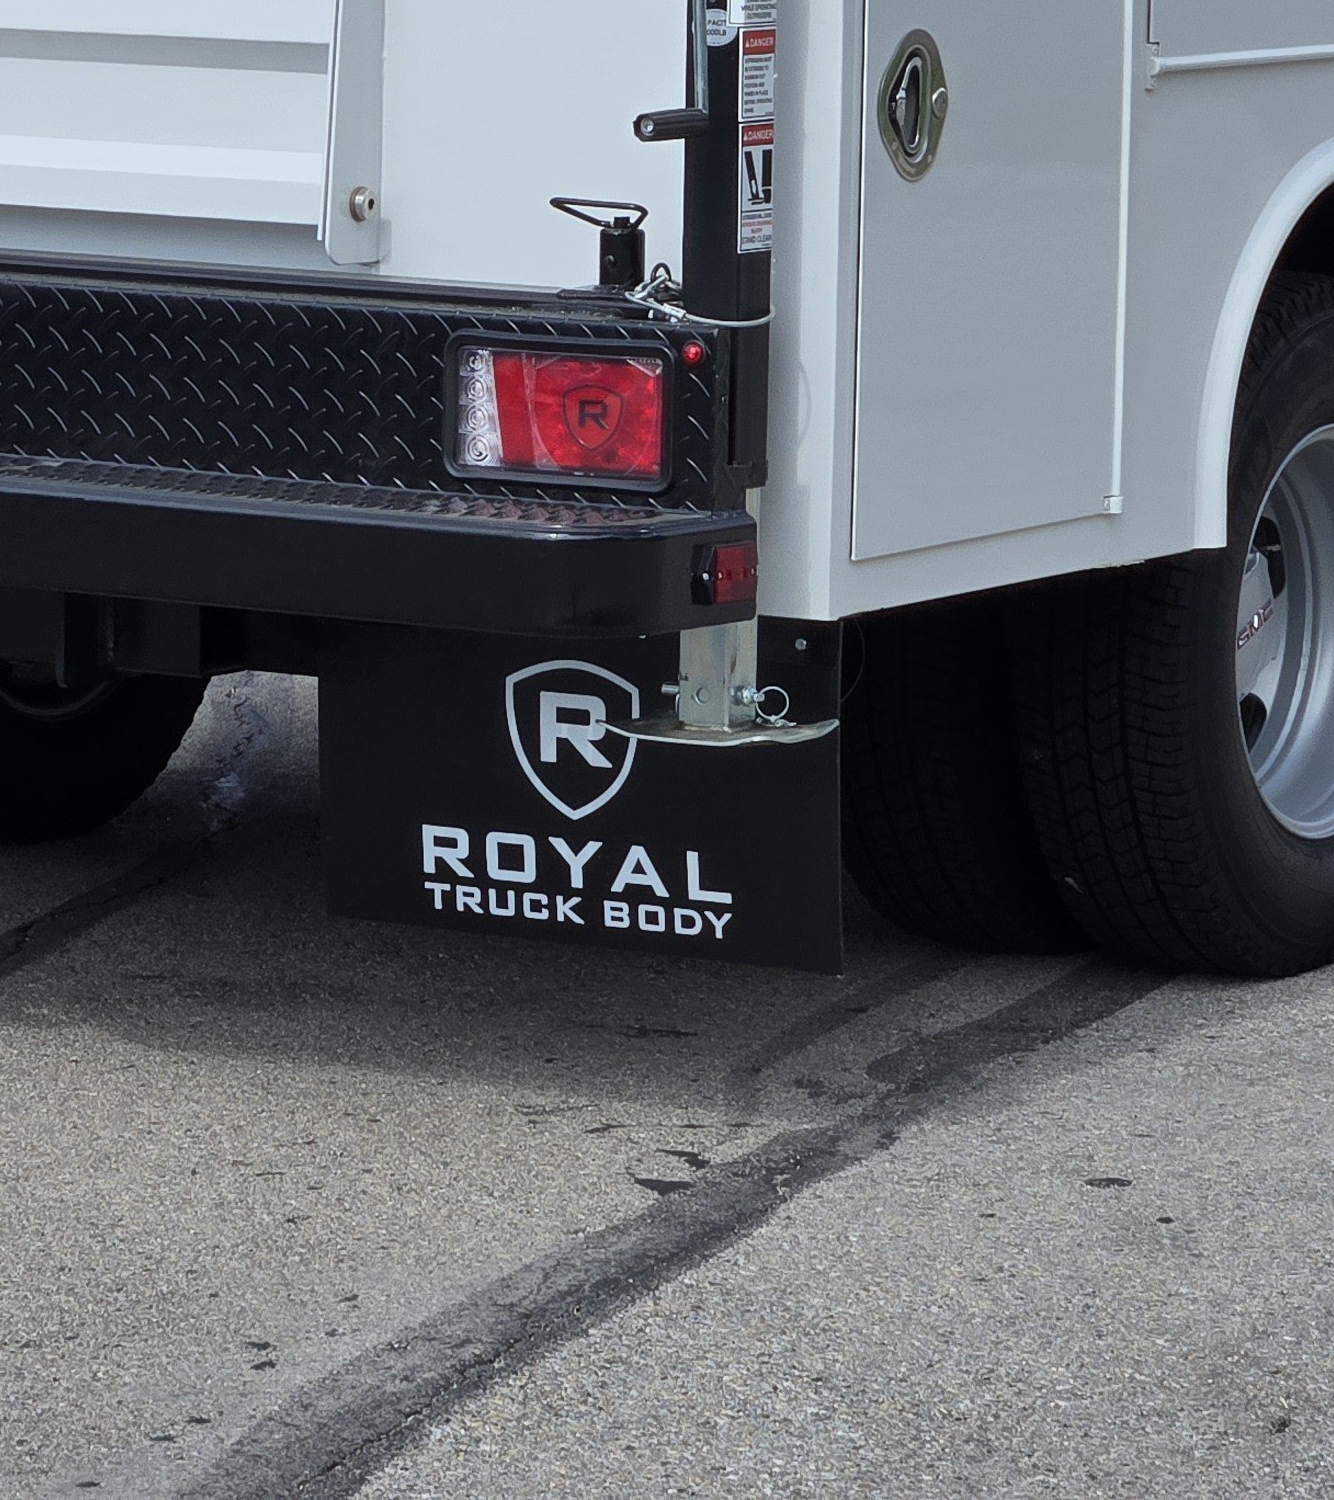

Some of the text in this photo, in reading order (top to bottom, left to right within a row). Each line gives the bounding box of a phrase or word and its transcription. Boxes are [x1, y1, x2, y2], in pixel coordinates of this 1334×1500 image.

[578, 399, 608, 430] R
[1237, 598, 1274, 650] GMC
[539, 690, 613, 769] R
[421, 823, 733, 905] ROYAL
[424, 881, 733, 940] TRUCK BODY
